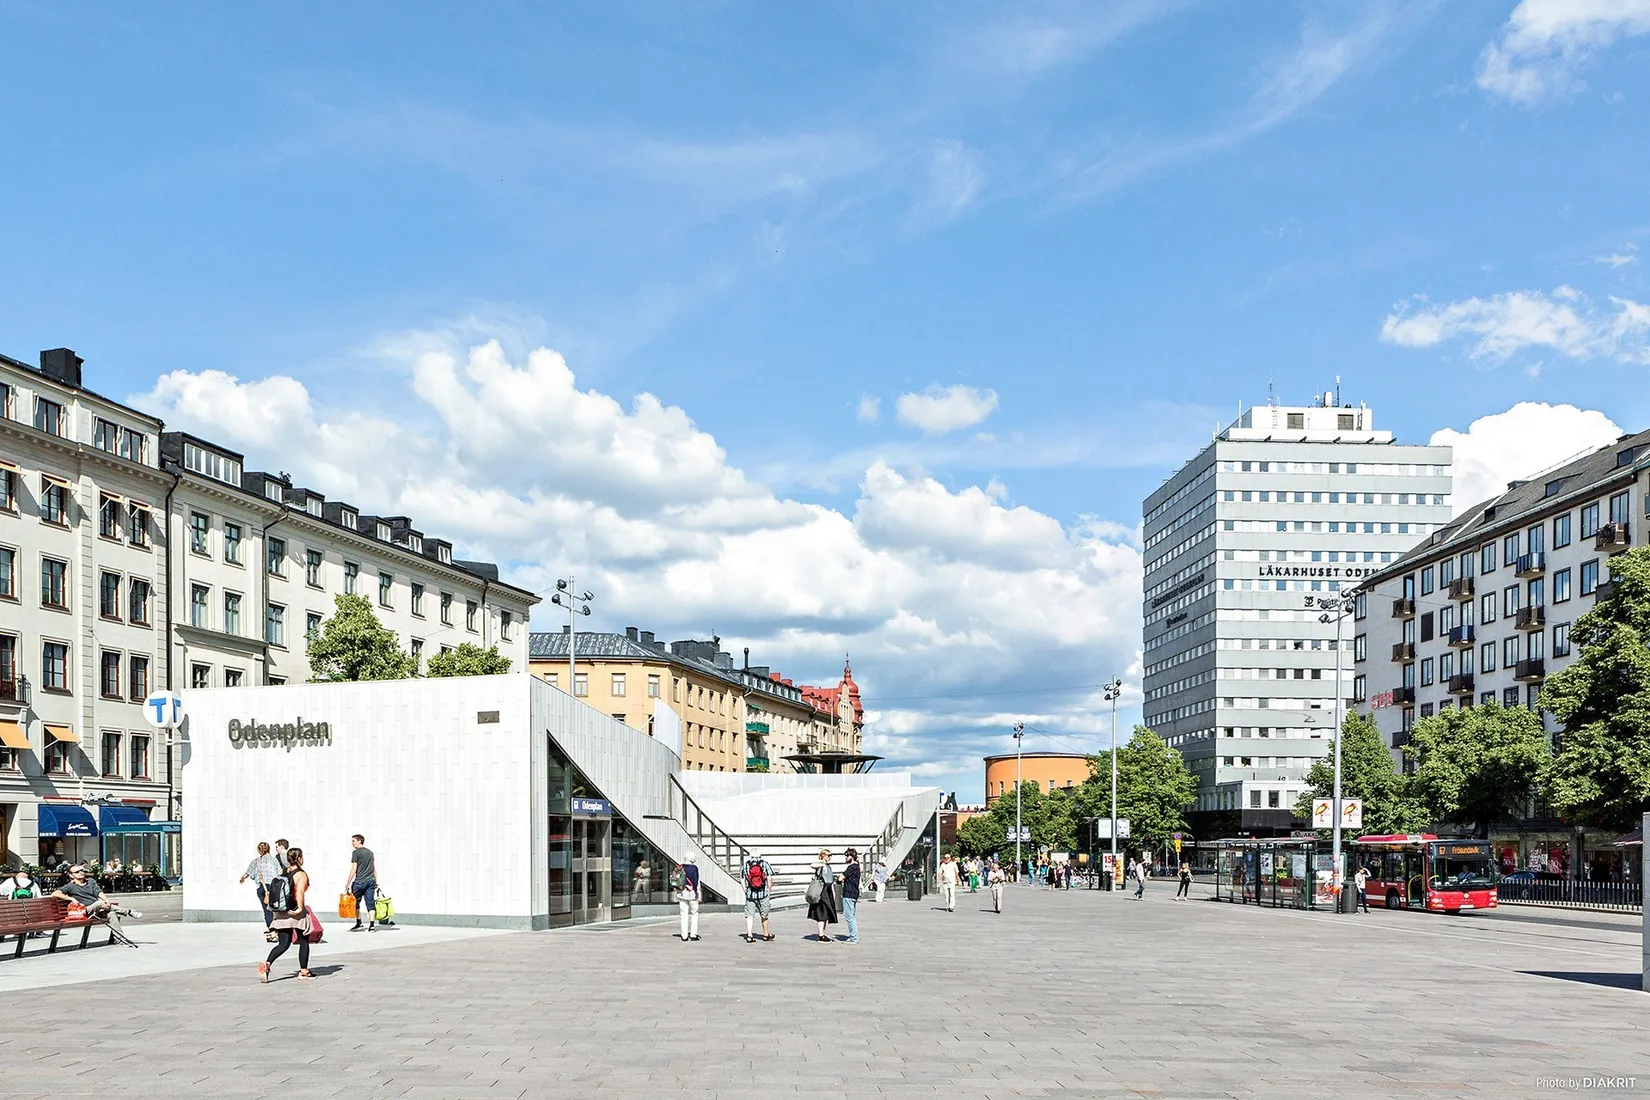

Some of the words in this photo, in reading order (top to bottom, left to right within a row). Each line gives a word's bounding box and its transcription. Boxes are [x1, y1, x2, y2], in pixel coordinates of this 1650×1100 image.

[1259, 565, 1340, 577] LÄKARHUSET
[1345, 567, 1380, 578] ODEN
[149, 697, 167, 723] T
[1371, 691, 1394, 710] SEB
[228, 716, 331, 750] Odenplan
